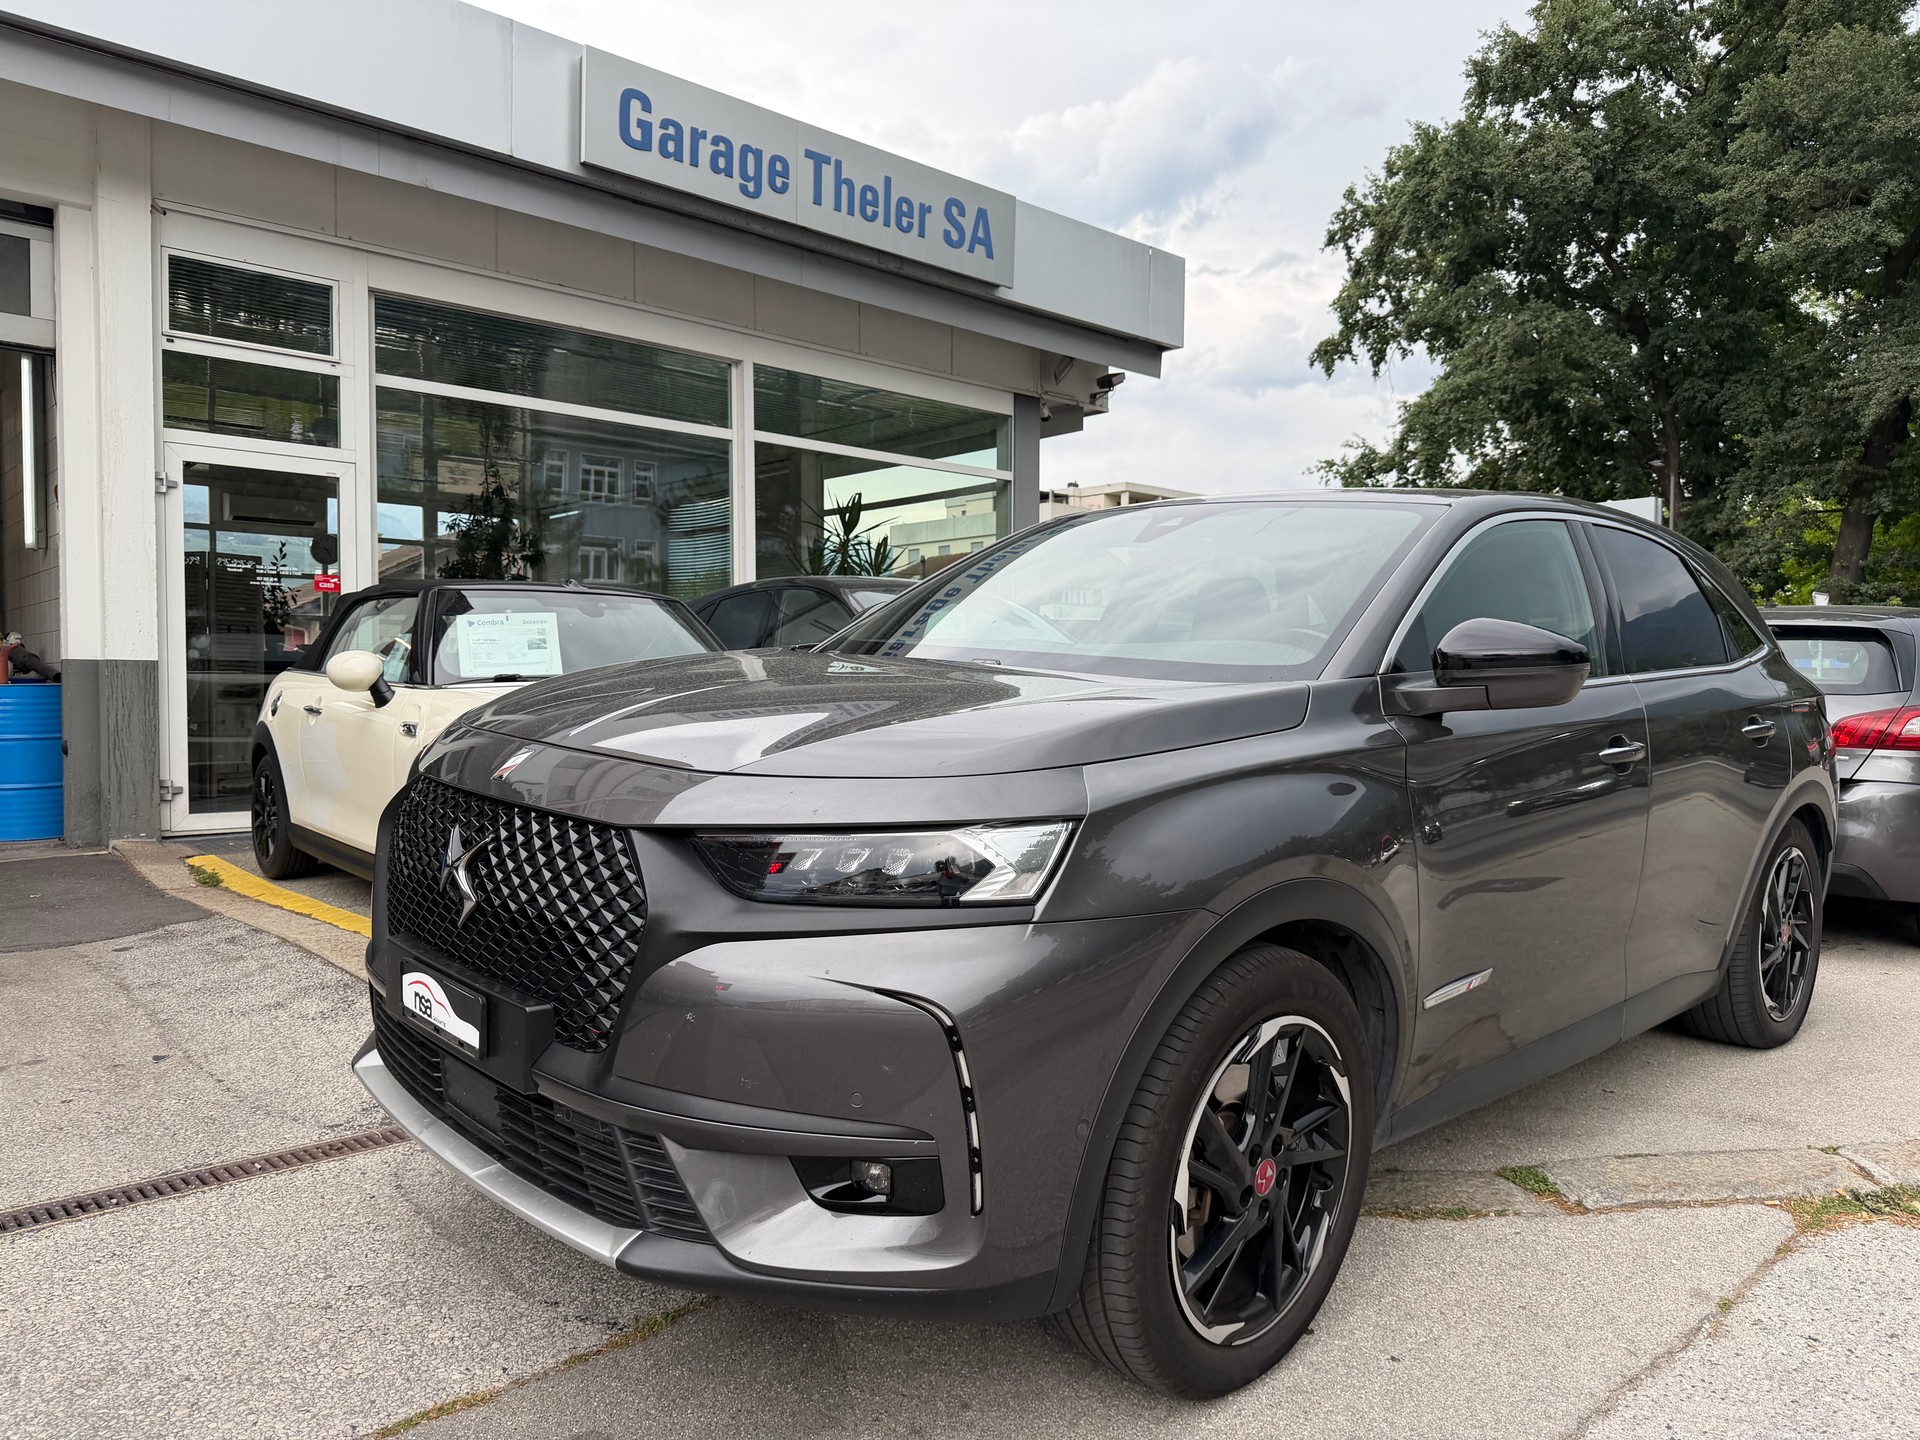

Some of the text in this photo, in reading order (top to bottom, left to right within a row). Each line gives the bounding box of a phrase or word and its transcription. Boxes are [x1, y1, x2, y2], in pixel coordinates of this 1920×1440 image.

[619, 88, 995, 260] Garage Theler SA
[414, 991, 432, 1018] nsa
